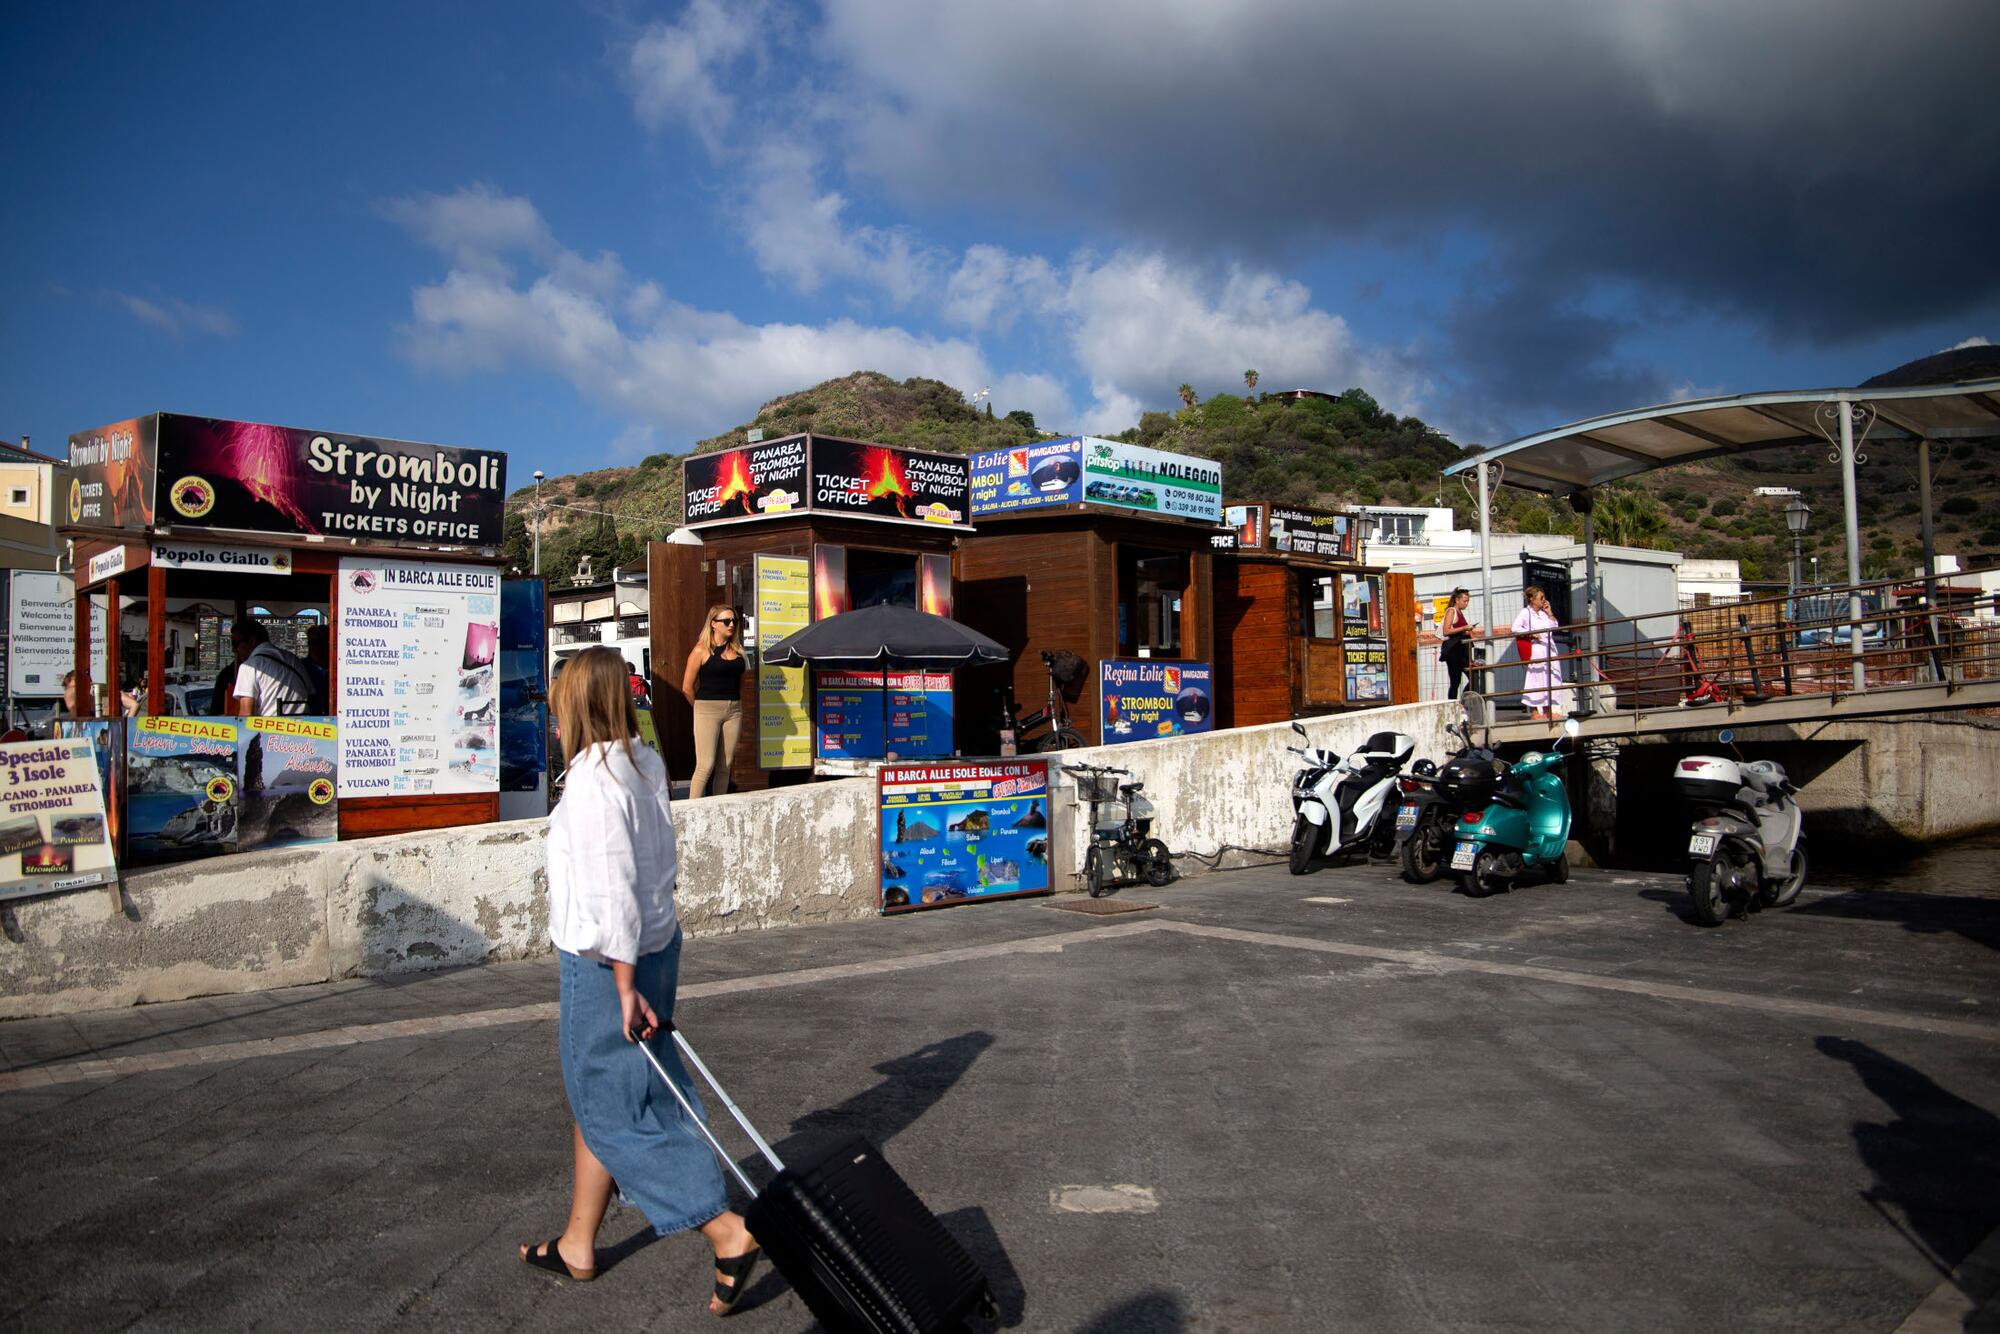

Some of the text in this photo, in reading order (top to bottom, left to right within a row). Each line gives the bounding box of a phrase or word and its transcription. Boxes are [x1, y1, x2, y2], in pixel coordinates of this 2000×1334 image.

[70, 432, 133, 467] Stromboli by Night
[753, 442, 802, 462] PANAREA
[978, 453, 1008, 469] Eolie
[1029, 443, 1071, 458] NAVIGAZIONE
[308, 436, 498, 489] Stromboli
[749, 454, 805, 474] STROMBOLI
[909, 459, 964, 475] PANAREA
[1087, 455, 1120, 471] pitstop
[754, 467, 801, 485] BY NIGHT
[904, 470, 967, 487] STROMBOLI
[972, 472, 1003, 488] MBOLI
[1160, 461, 1219, 486] NOLEGGIO
[816, 475, 870, 490] TICKET
[911, 481, 926, 492] BY
[929, 484, 963, 497] NIGHT
[81, 483, 102, 498] TICKETS
[350, 480, 461, 514] by Night
[688, 486, 722, 503] TICKET
[817, 489, 868, 505] OFFICE
[976, 488, 996, 500] night
[1044, 493, 1069, 502] VULCANO
[83, 504, 100, 518] OFFICE
[688, 500, 720, 517] OFFICE
[1281, 510, 1291, 519] Isole
[1292, 512, 1303, 521] Eolie
[322, 512, 479, 539] TICKETS OFFICE
[1294, 539, 1338, 555] TICKET OFFICE
[95, 553, 123, 575] Popolo Giallo
[155, 547, 269, 566] Popolo Giallo
[384, 569, 396, 583] IN
[399, 570, 434, 585] BARCA
[437, 573, 462, 586] ALLE
[465, 574, 494, 588] EOLIE
[21, 611, 62, 619] Welcome
[346, 607, 391, 617] PANAREA
[403, 613, 420, 621] Part.
[19, 623, 66, 631] Bienvenue
[345, 619, 398, 628] STROMBOLI
[12, 635, 65, 643] Willkommen
[346, 639, 386, 647] SCALATA
[15, 647, 70, 655] Bienvenidos
[346, 649, 399, 658] AL CRATERE
[403, 644, 419, 652] Part.
[1347, 652, 1385, 662] TICKET OFFICE
[346, 677, 379, 686] LIPARI
[829, 677, 845, 685] BARCA
[846, 677, 857, 686] ALLE
[858, 677, 872, 686] ISOLE
[873, 677, 884, 686] EOLI
[1104, 664, 1137, 687] Regina
[1140, 665, 1163, 682] Eolie
[394, 680, 411, 688] Part.
[347, 688, 384, 696] SALINA
[1121, 697, 1173, 710] STROMBOLI
[346, 709, 390, 717] FILICUDI
[1130, 711, 1159, 723] by night
[145, 719, 231, 739] SPECIALE
[253, 718, 332, 738] SPECIALE
[351, 720, 390, 728] ALICUDI
[134, 731, 234, 756] Lipari Salina
[266, 736, 315, 755] Filicudi
[346, 739, 391, 748] VULCANO,
[0, 747, 70, 768] Speciale
[346, 748, 396, 757] PANAREA E
[285, 754, 333, 774] Alicudi
[346, 760, 396, 768] STROMBOLI
[8, 765, 66, 786] 3 Isole
[885, 765, 1030, 782] IN BARCA ALLE ISOLE EOLIE CON IL
[45, 783, 97, 797] PANAREA
[347, 779, 390, 788] VULCANO
[9, 798, 73, 813] STROMBOLI
[4, 838, 42, 853] Vulcano
[25, 864, 68, 874] Stromboli
[54, 878, 85, 888] Domani
